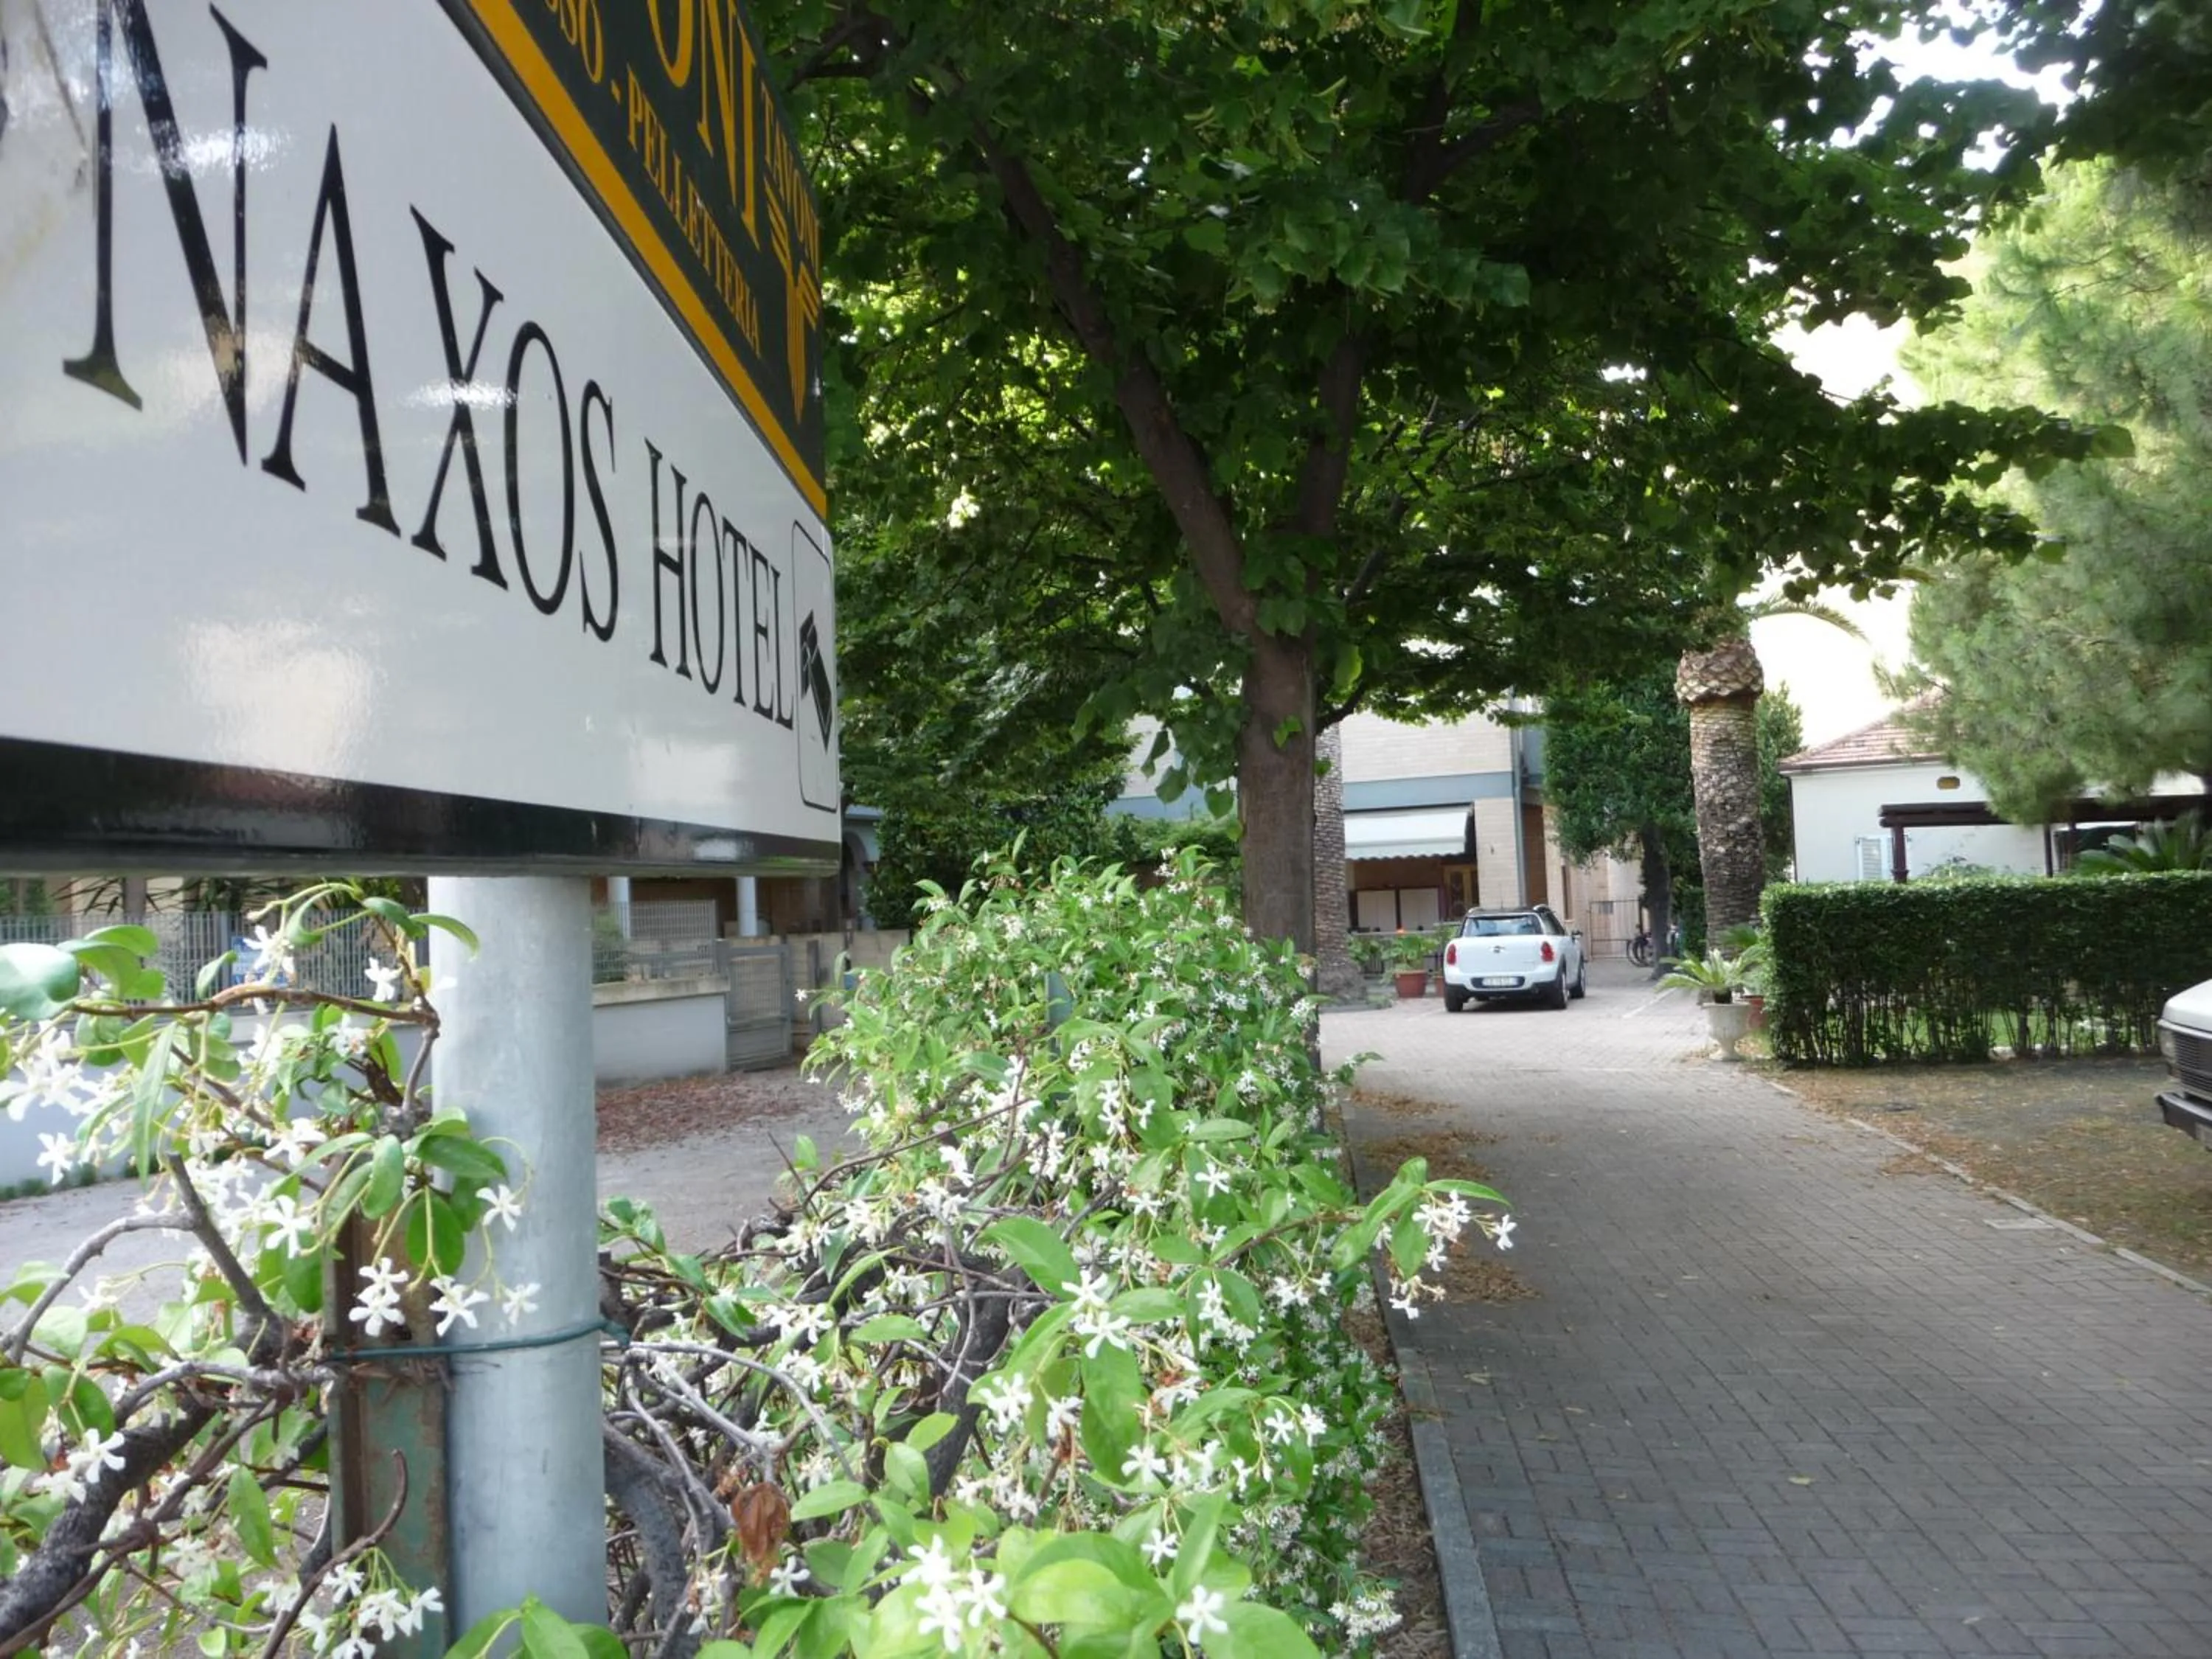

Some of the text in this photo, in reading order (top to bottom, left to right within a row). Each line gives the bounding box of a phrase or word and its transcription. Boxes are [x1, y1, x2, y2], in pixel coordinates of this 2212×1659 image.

[63, 0, 793, 730] NAXOS HOTEL
[627, 62, 761, 360] PELLETTERIA
